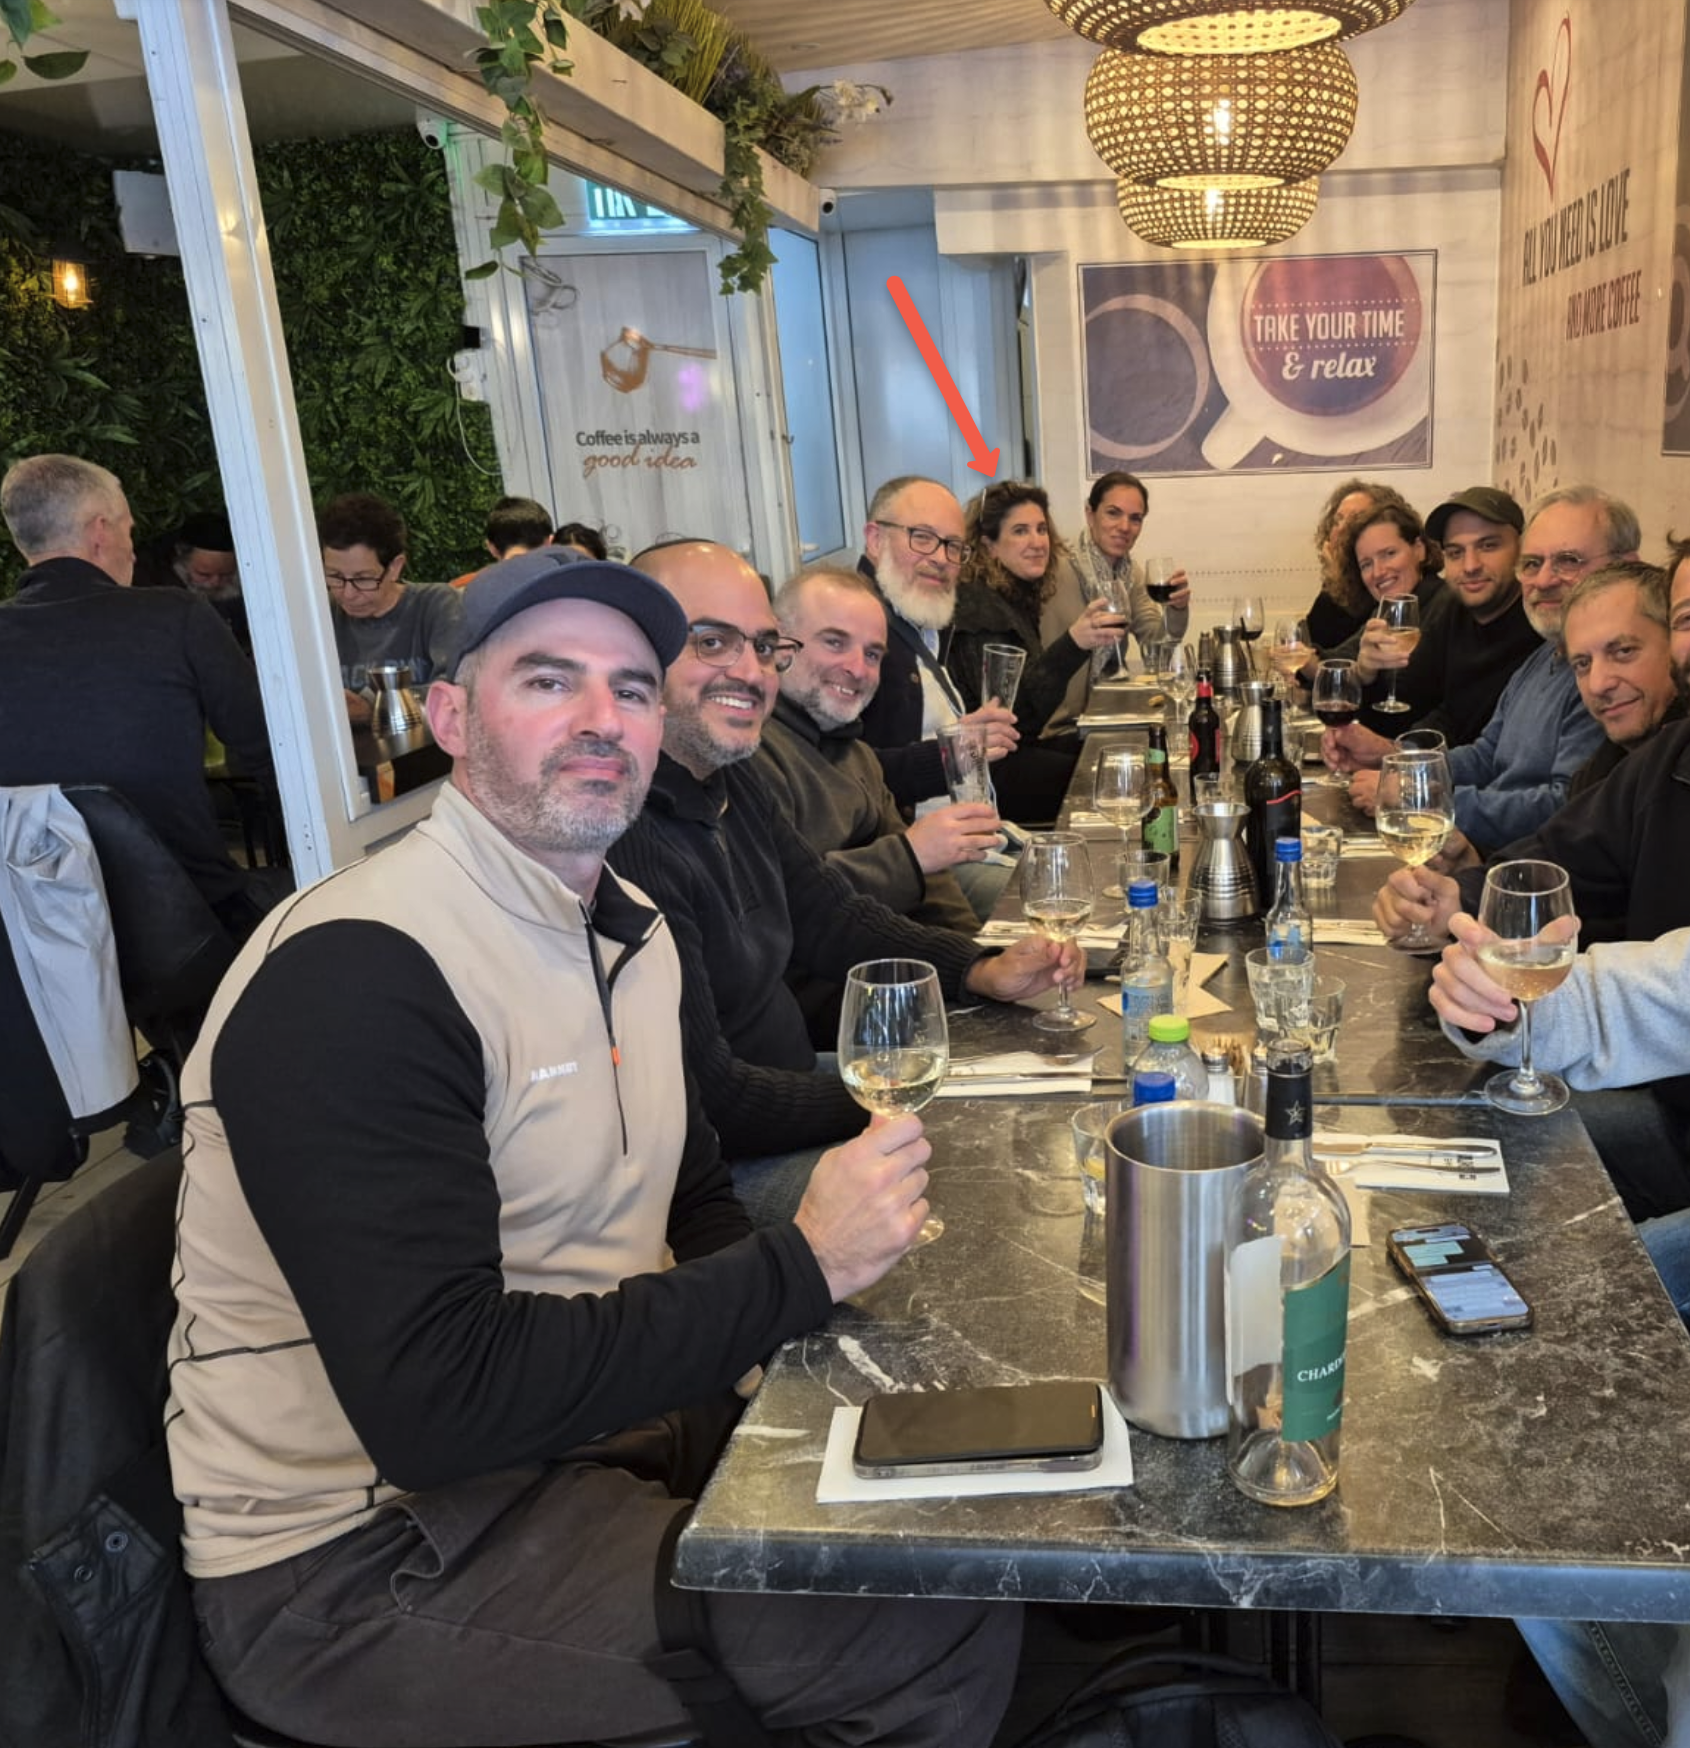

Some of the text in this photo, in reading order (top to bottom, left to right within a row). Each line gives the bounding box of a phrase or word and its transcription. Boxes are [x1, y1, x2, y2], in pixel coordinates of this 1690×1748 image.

[1522, 167, 1630, 287] ALL YOU NEED IS LOVE
[1582, 282, 1607, 337] MORE
[1607, 270, 1642, 330] COFFEE
[1253, 309, 1405, 342] TAKE YOUR TIME
[1282, 351, 1377, 380] & relax
[575, 429, 700, 448] Coffee is always a
[583, 443, 698, 480] good idea
